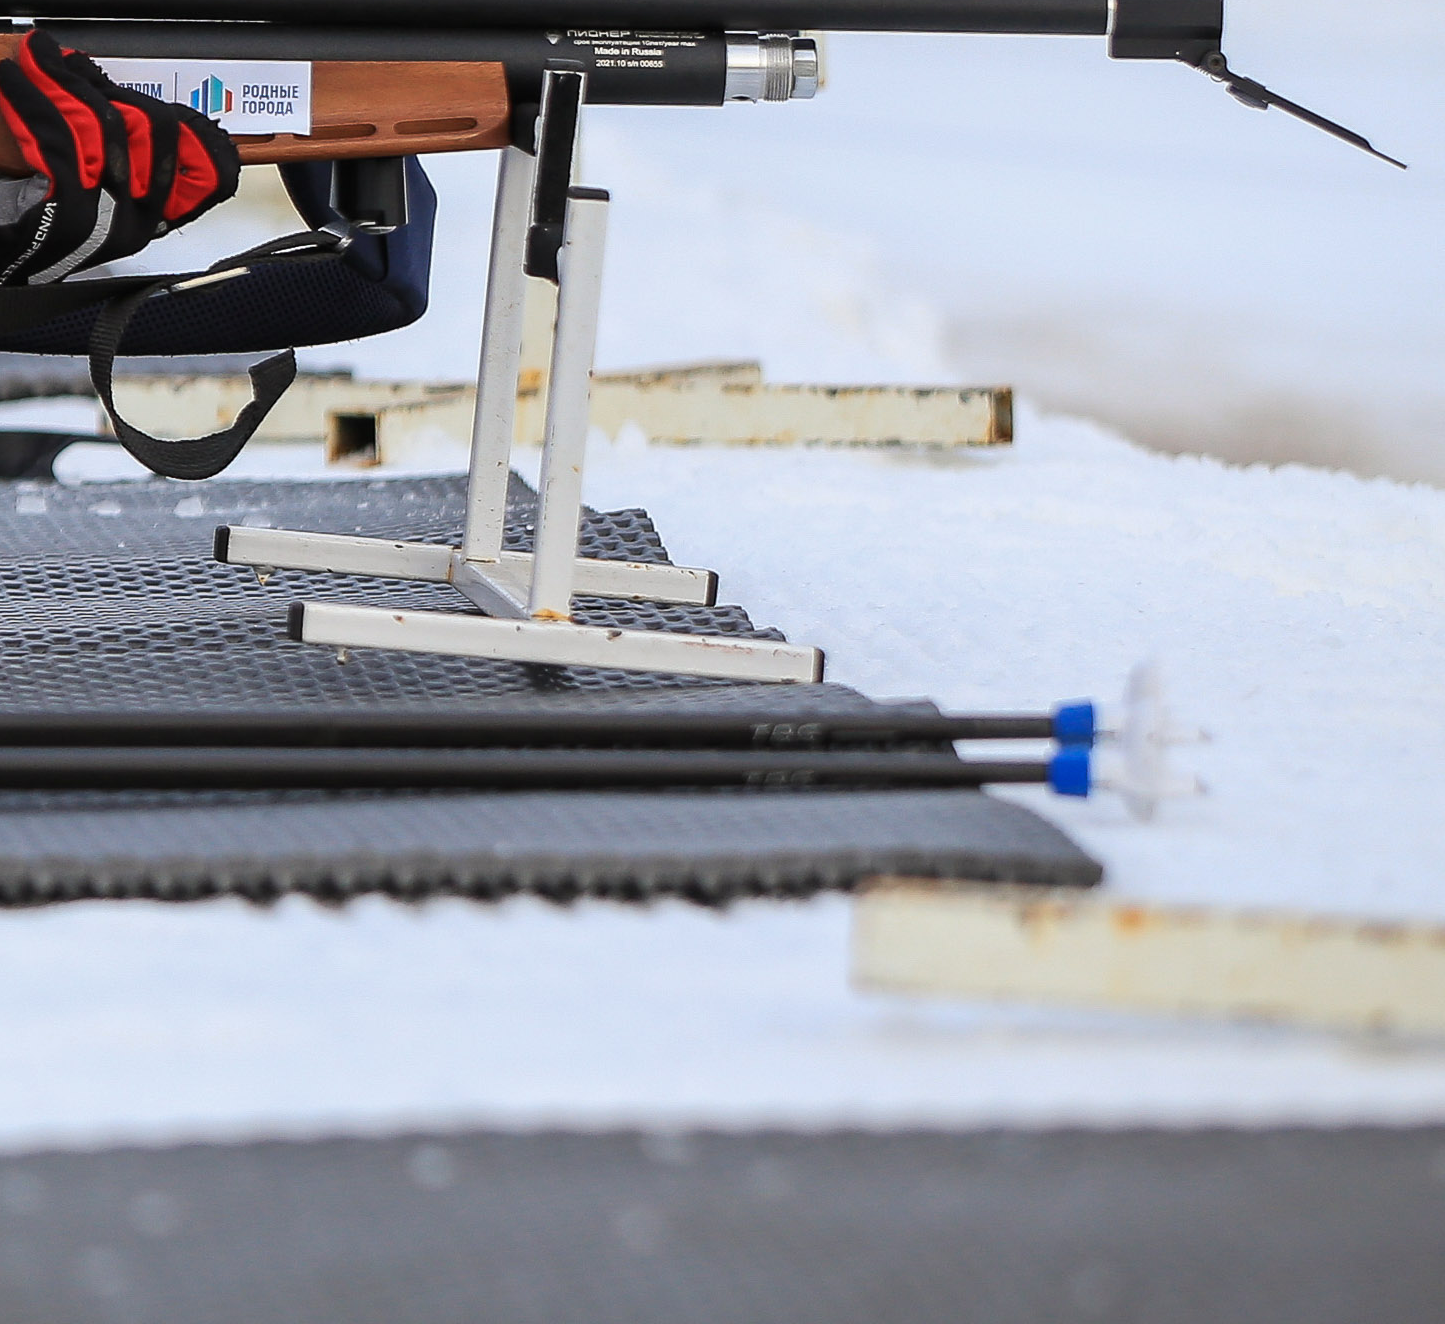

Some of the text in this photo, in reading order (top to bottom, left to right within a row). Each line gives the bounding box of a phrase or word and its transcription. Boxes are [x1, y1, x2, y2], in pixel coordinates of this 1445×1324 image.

[567, 30, 631, 38] ПИОНЕР
[594, 47, 662, 56] Made in Russia
[241, 84, 299, 101] РОДНЫЕ
[241, 101, 294, 116] ГОРОДА
